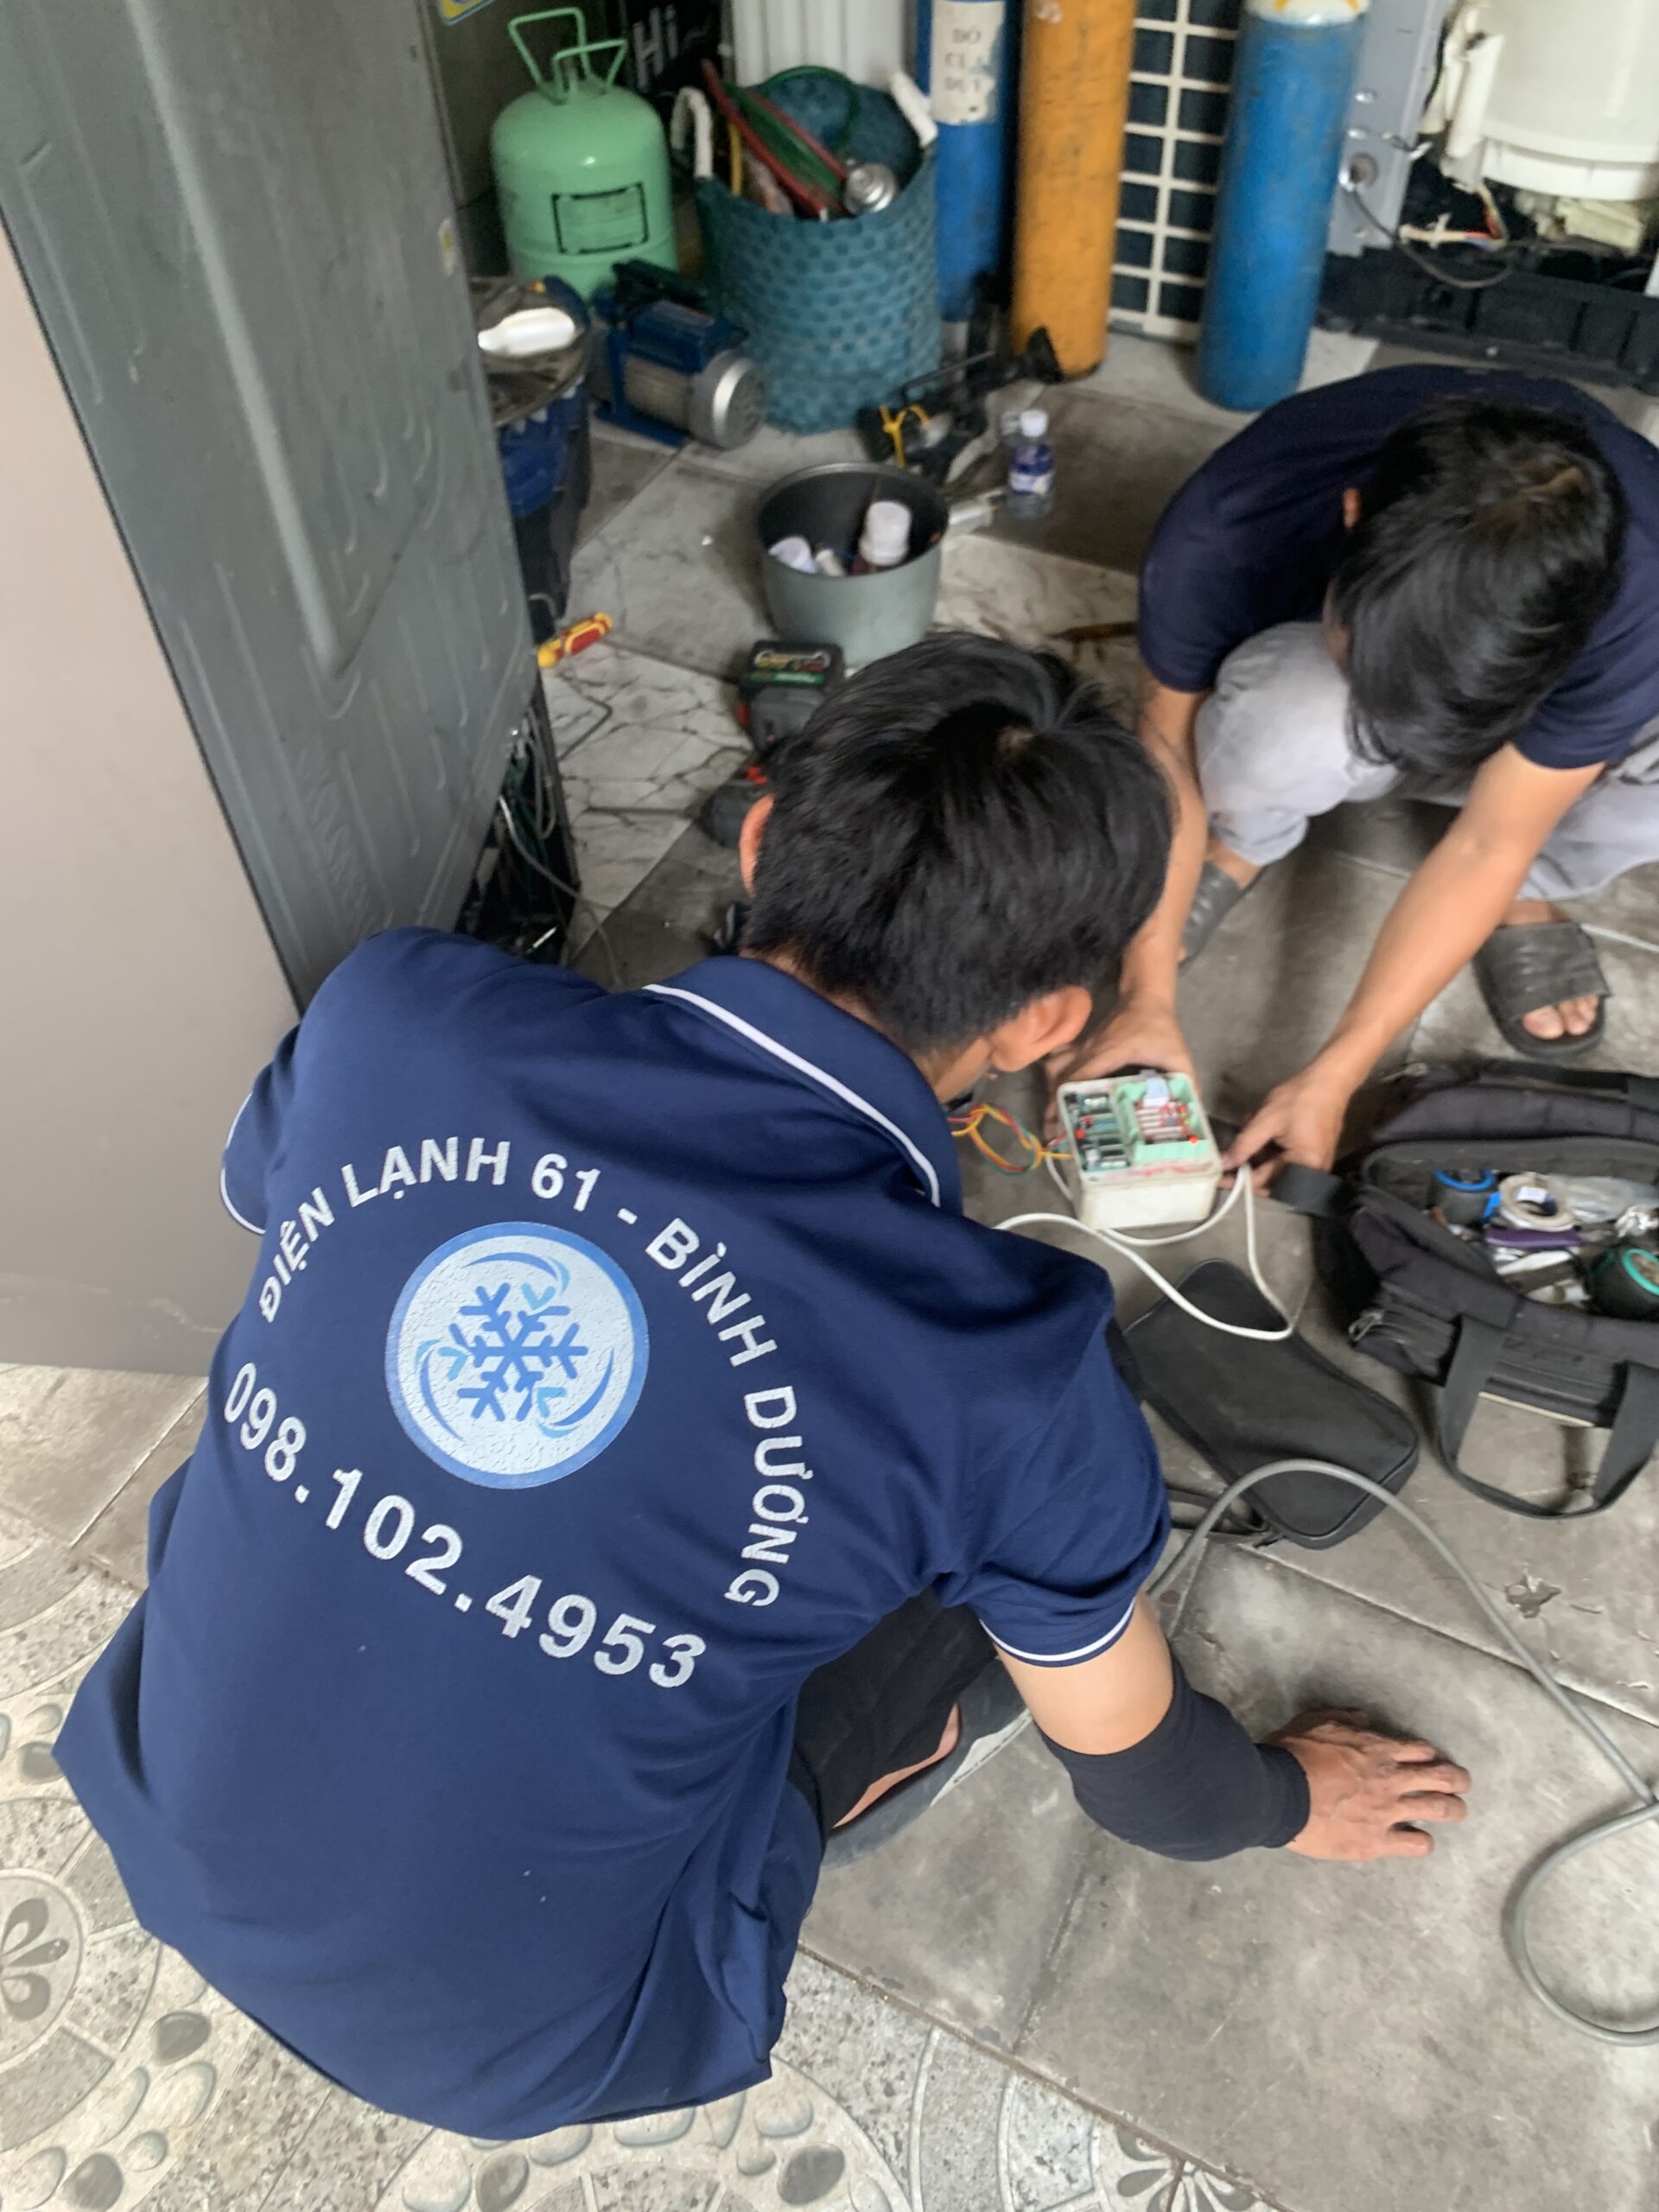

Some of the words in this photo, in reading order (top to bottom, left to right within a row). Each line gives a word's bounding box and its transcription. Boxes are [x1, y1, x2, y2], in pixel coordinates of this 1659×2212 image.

[224, 1362, 707, 1689] 098.102.4953
[258, 1186, 335, 1323] ĐIỆN
[340, 1136, 511, 1208] LẠNH
[531, 1153, 601, 1212] 61
[617, 1208, 638, 1224] -
[645, 1217, 778, 1367] BÌNH
[724, 1385, 814, 1607] DƯƠNG
